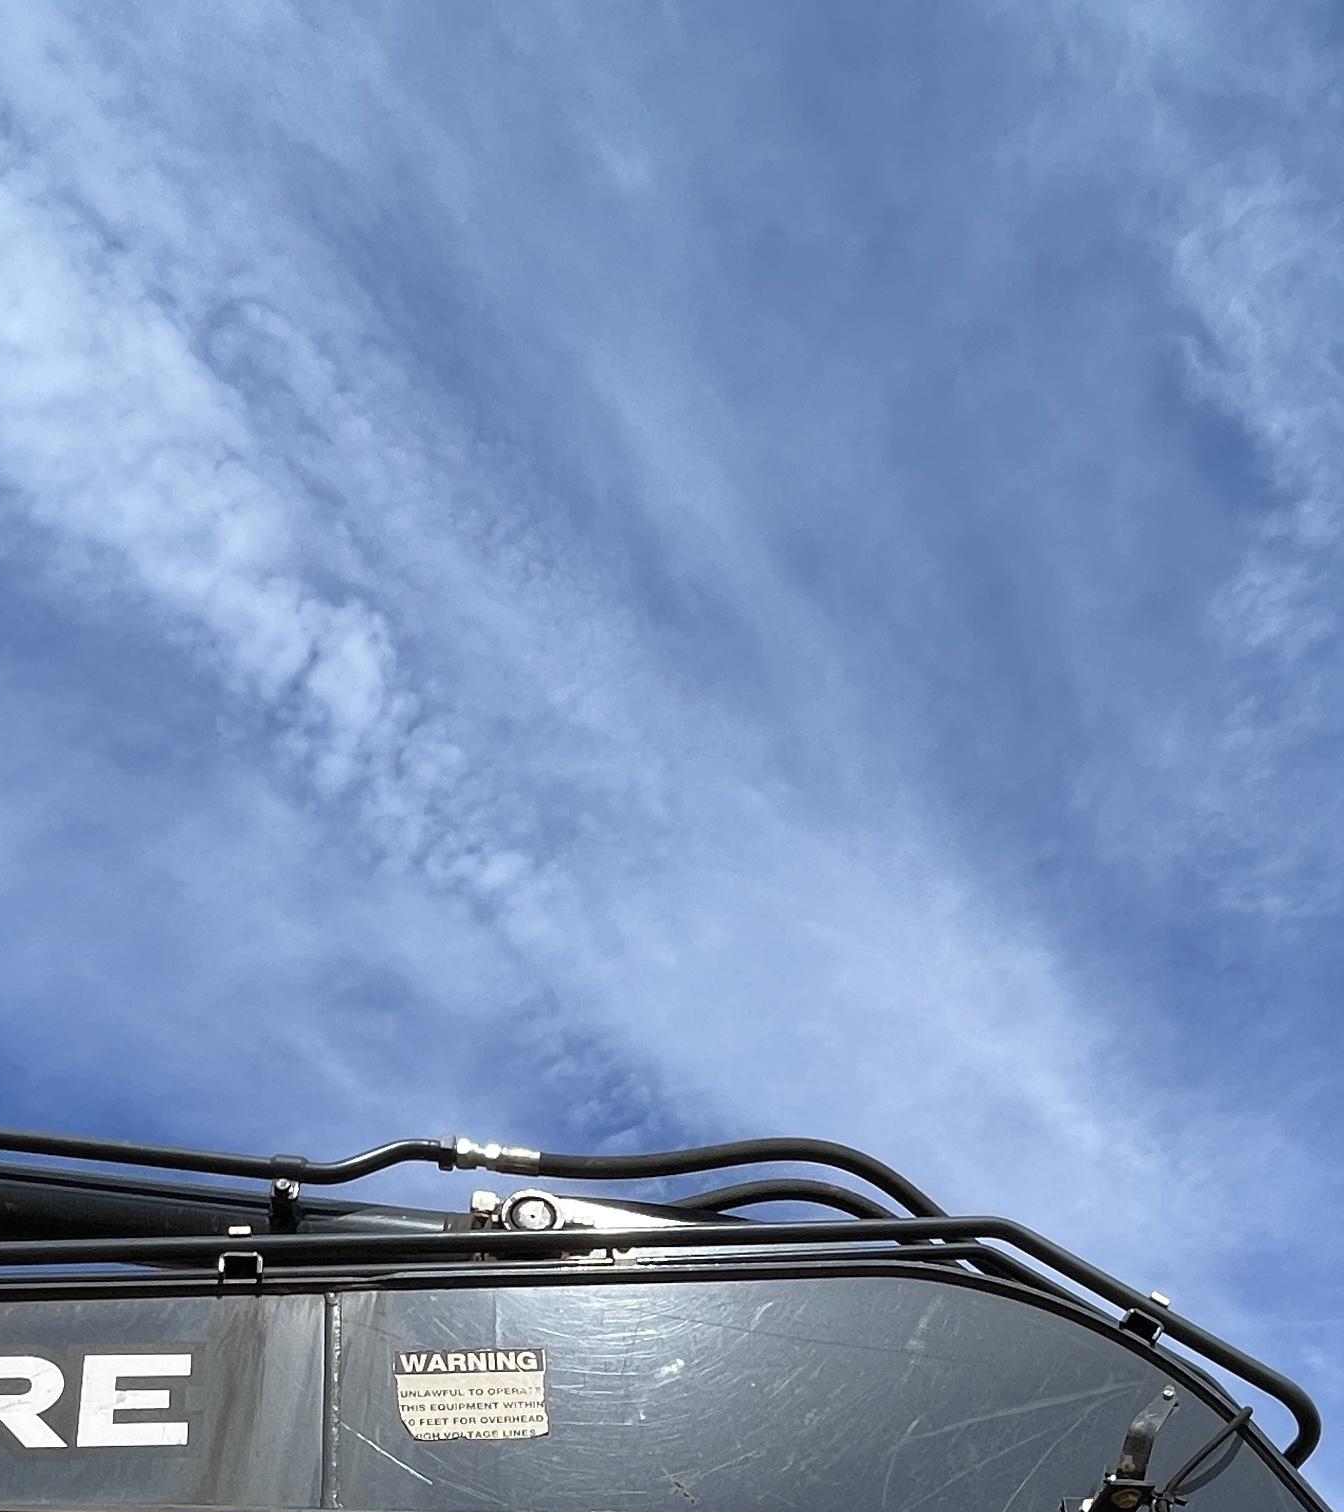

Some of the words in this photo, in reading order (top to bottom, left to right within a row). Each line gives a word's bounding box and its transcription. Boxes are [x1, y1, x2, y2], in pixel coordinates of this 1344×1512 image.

[399, 1351, 538, 1373] WARNING
[400, 1389, 465, 1398] UNLAWFUL
[468, 1388, 484, 1396] TO
[400, 1404, 426, 1412] THIS
[430, 1402, 499, 1412] EQUIPMENT
[503, 1401, 544, 1409] WITHIN
[419, 1418, 448, 1426] FEET
[453, 1416, 477, 1425] FOR
[480, 1415, 544, 1424] OVERHEAD
[444, 1430, 499, 1439] VOLTAGE
[503, 1429, 536, 1437] LINES
